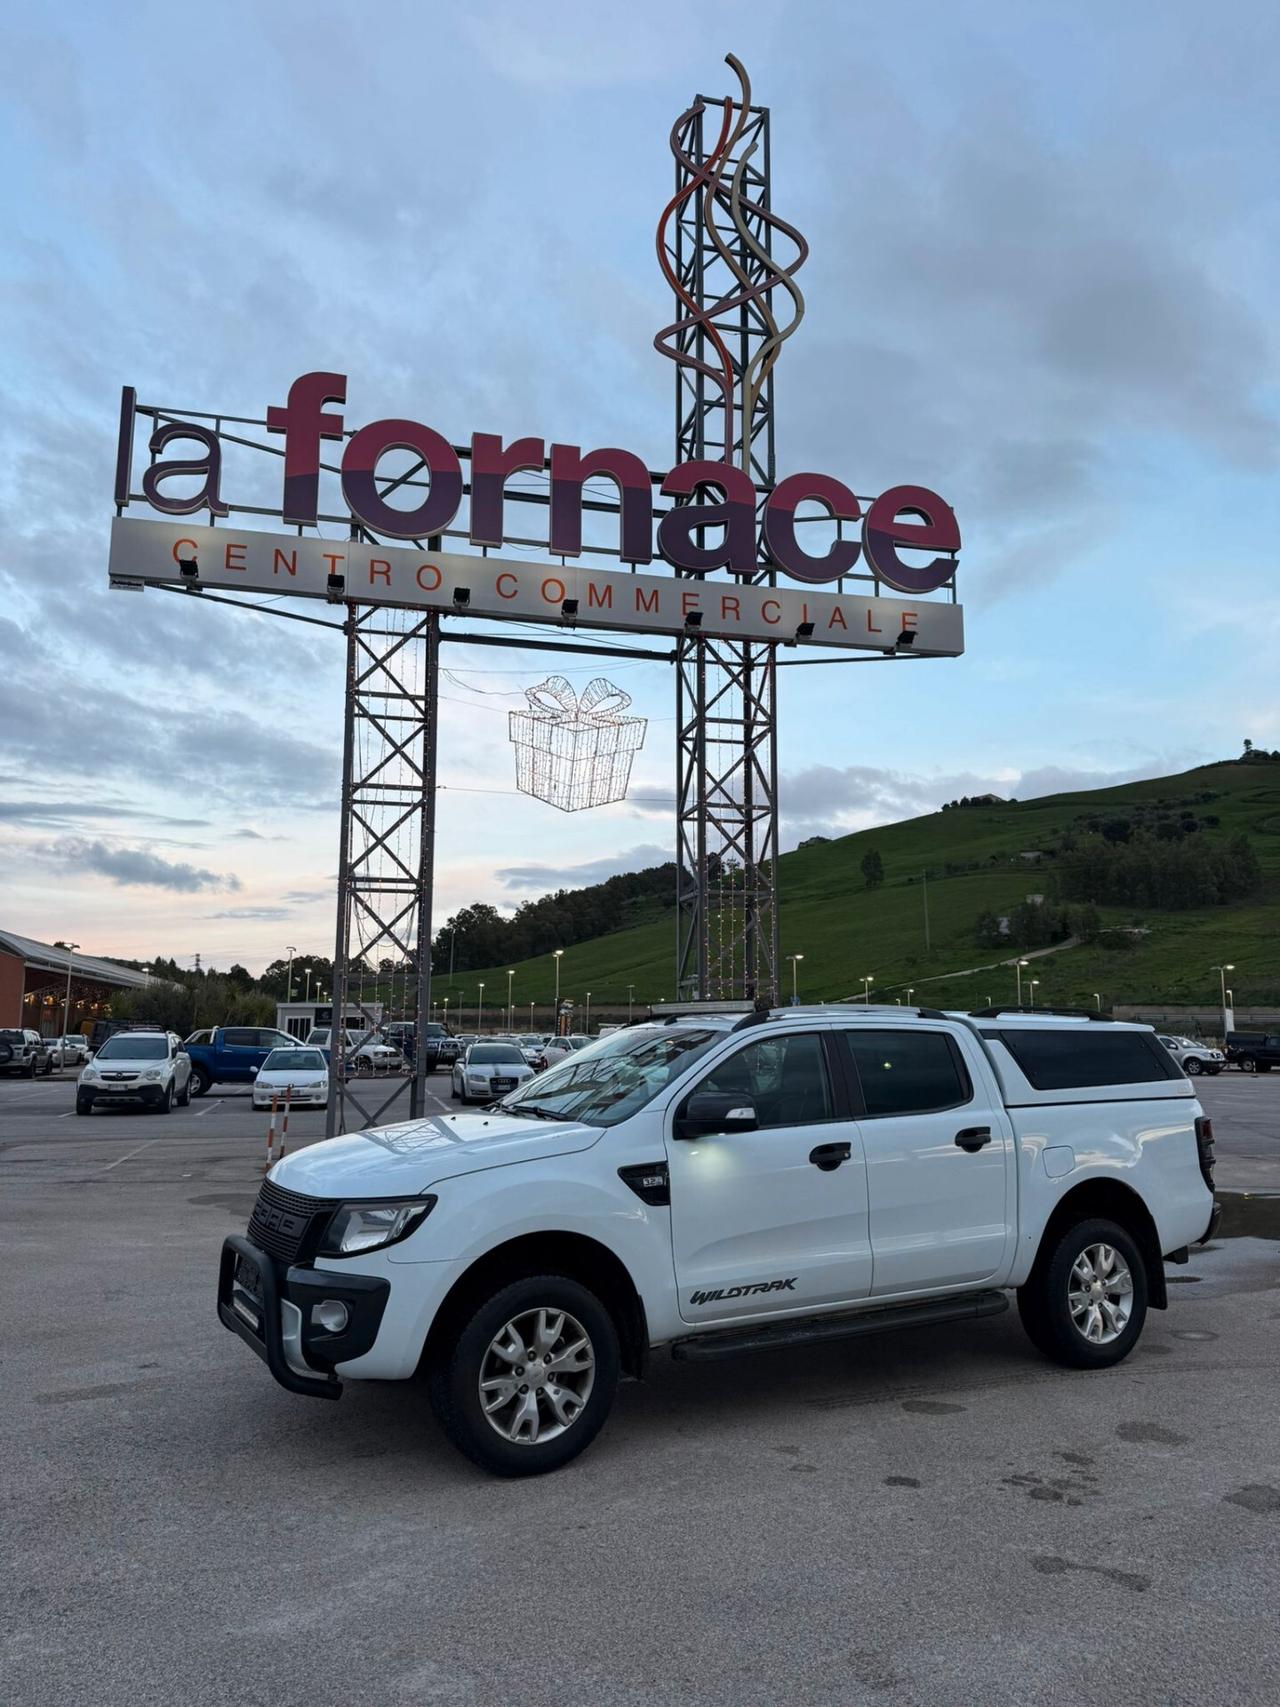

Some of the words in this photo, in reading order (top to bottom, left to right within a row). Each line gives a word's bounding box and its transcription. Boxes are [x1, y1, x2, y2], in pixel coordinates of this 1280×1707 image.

[114, 386, 229, 517] la
[267, 371, 961, 594] fornace
[172, 538, 442, 591] CENTRO
[495, 572, 918, 633] COMMERCIALE
[689, 1277, 798, 1305] WILDTRAK
